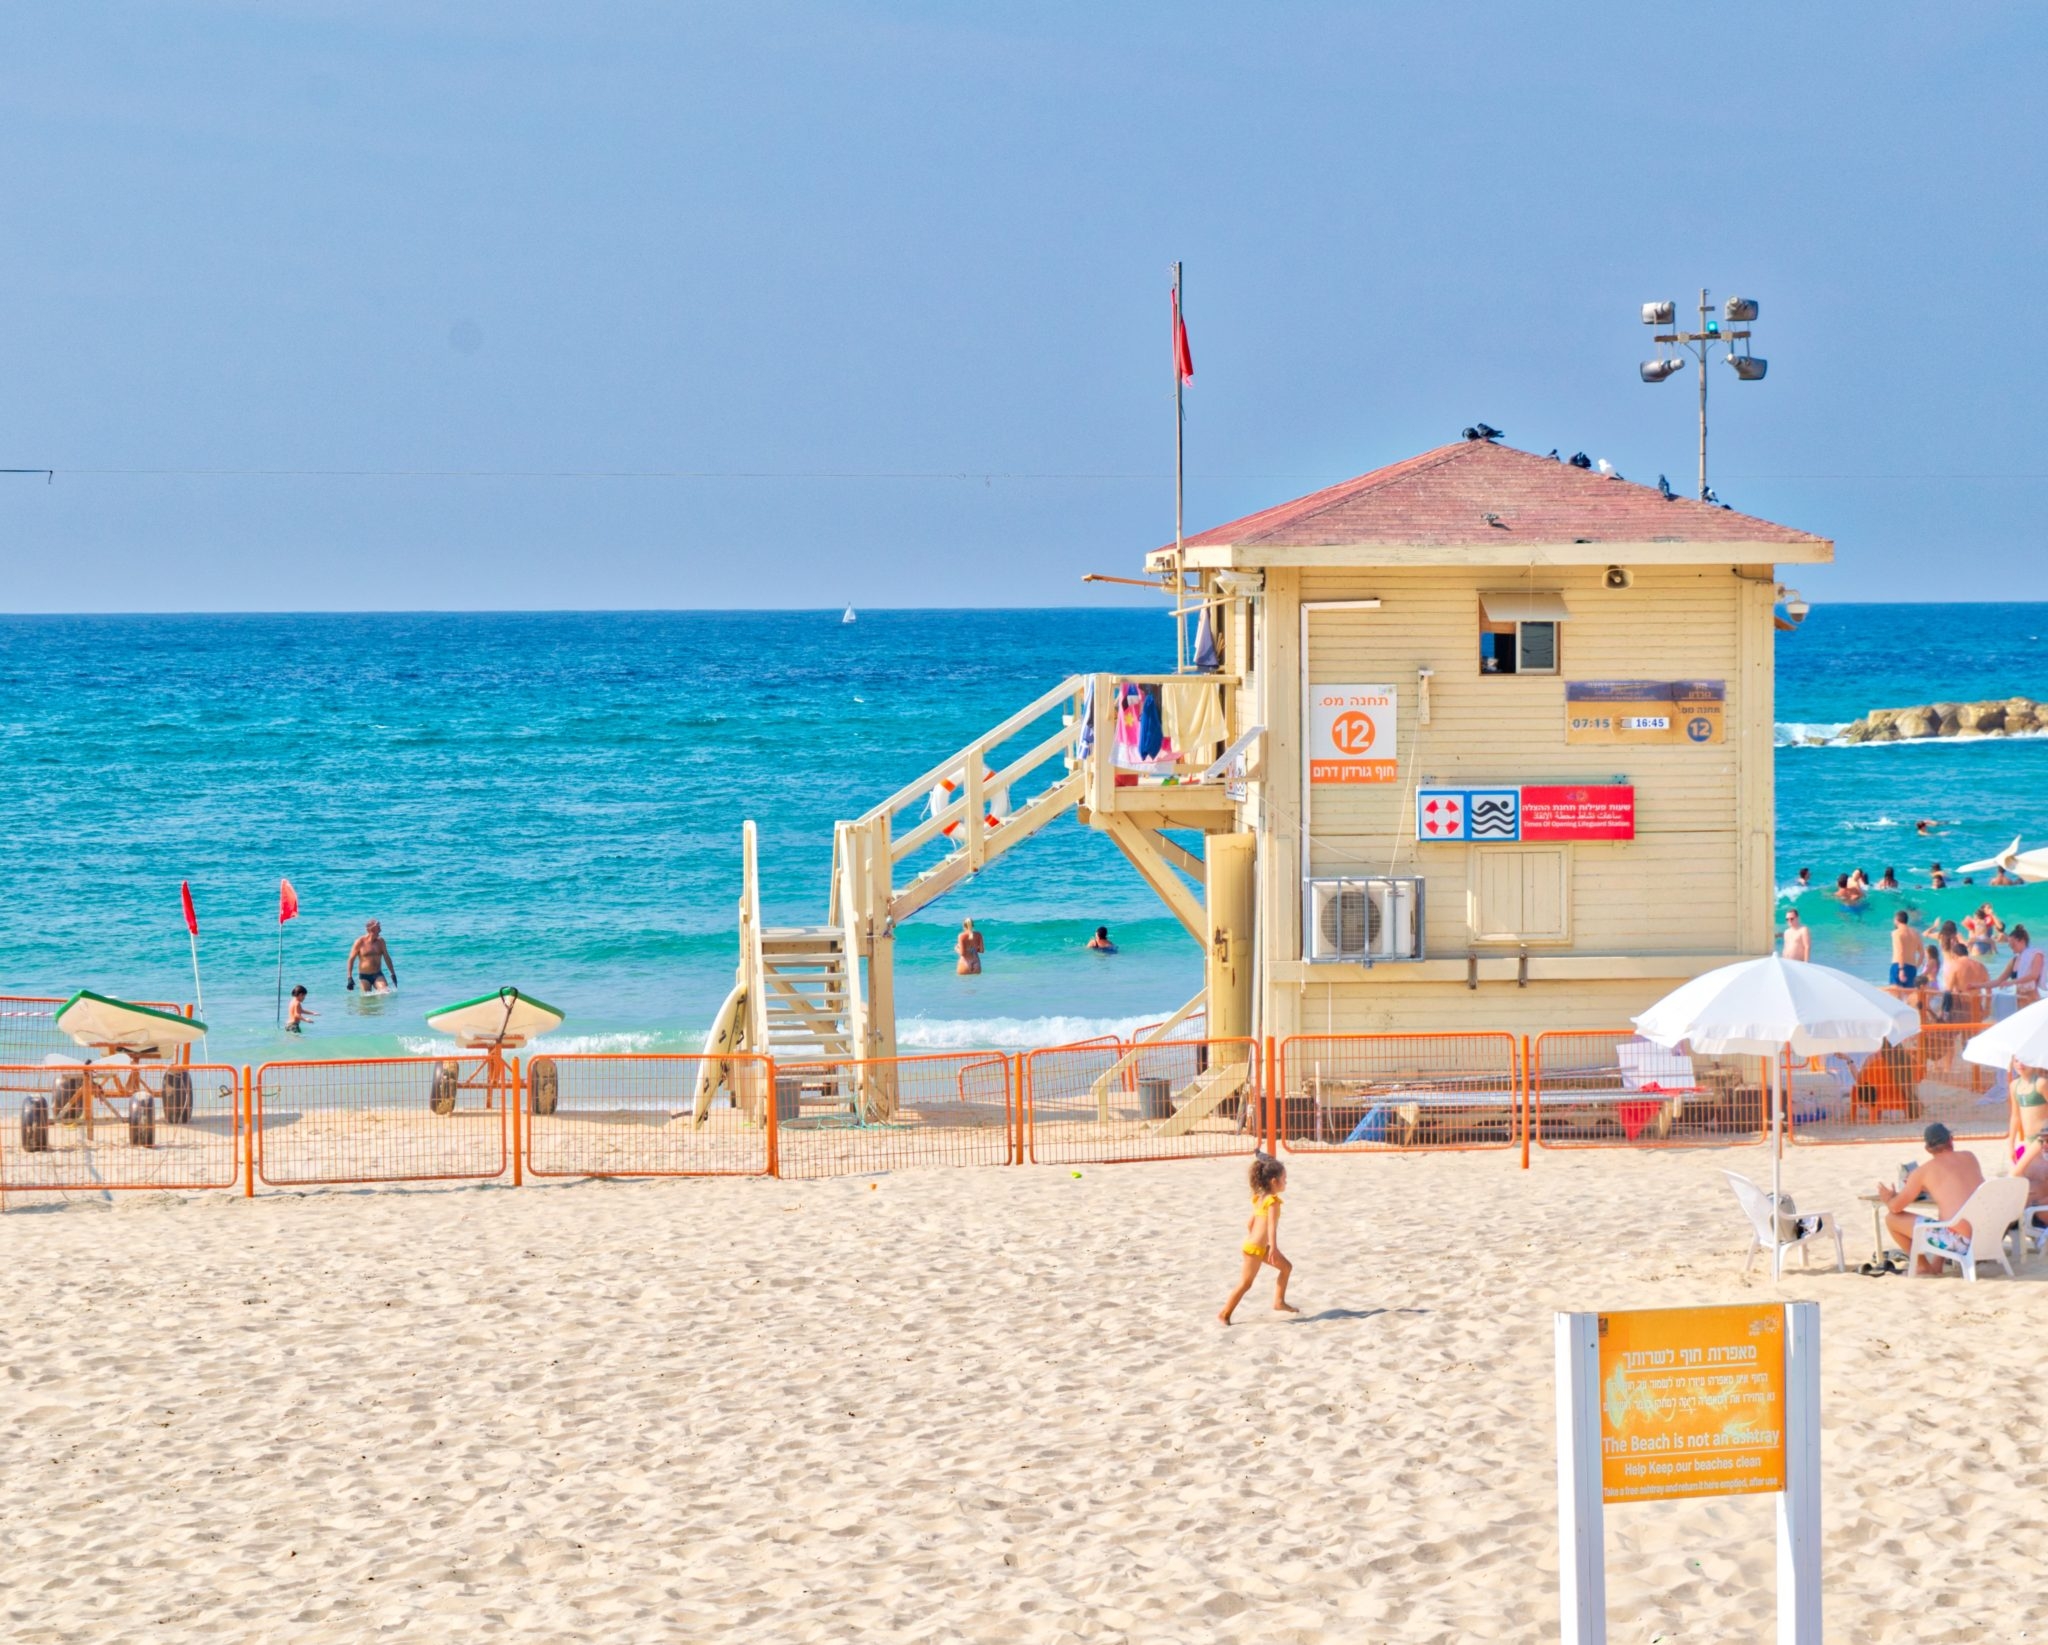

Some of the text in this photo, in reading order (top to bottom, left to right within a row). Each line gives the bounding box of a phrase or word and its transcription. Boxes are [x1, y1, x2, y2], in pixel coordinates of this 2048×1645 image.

[1319, 696, 1389, 706] תחנה מס.
[1572, 718, 1664, 728] 07:15 16:45
[1690, 722, 1710, 736] 12
[1335, 719, 1370, 748] 12
[1313, 765, 1394, 780] חוף גורדון דרום
[1680, 1348, 1702, 1366] חוף
[1707, 1344, 1757, 1361] מאפרות
[1603, 1430, 1780, 1453] The Beach is not an ashtray
[1625, 1456, 1761, 1477] Help Keep our beaches clean
